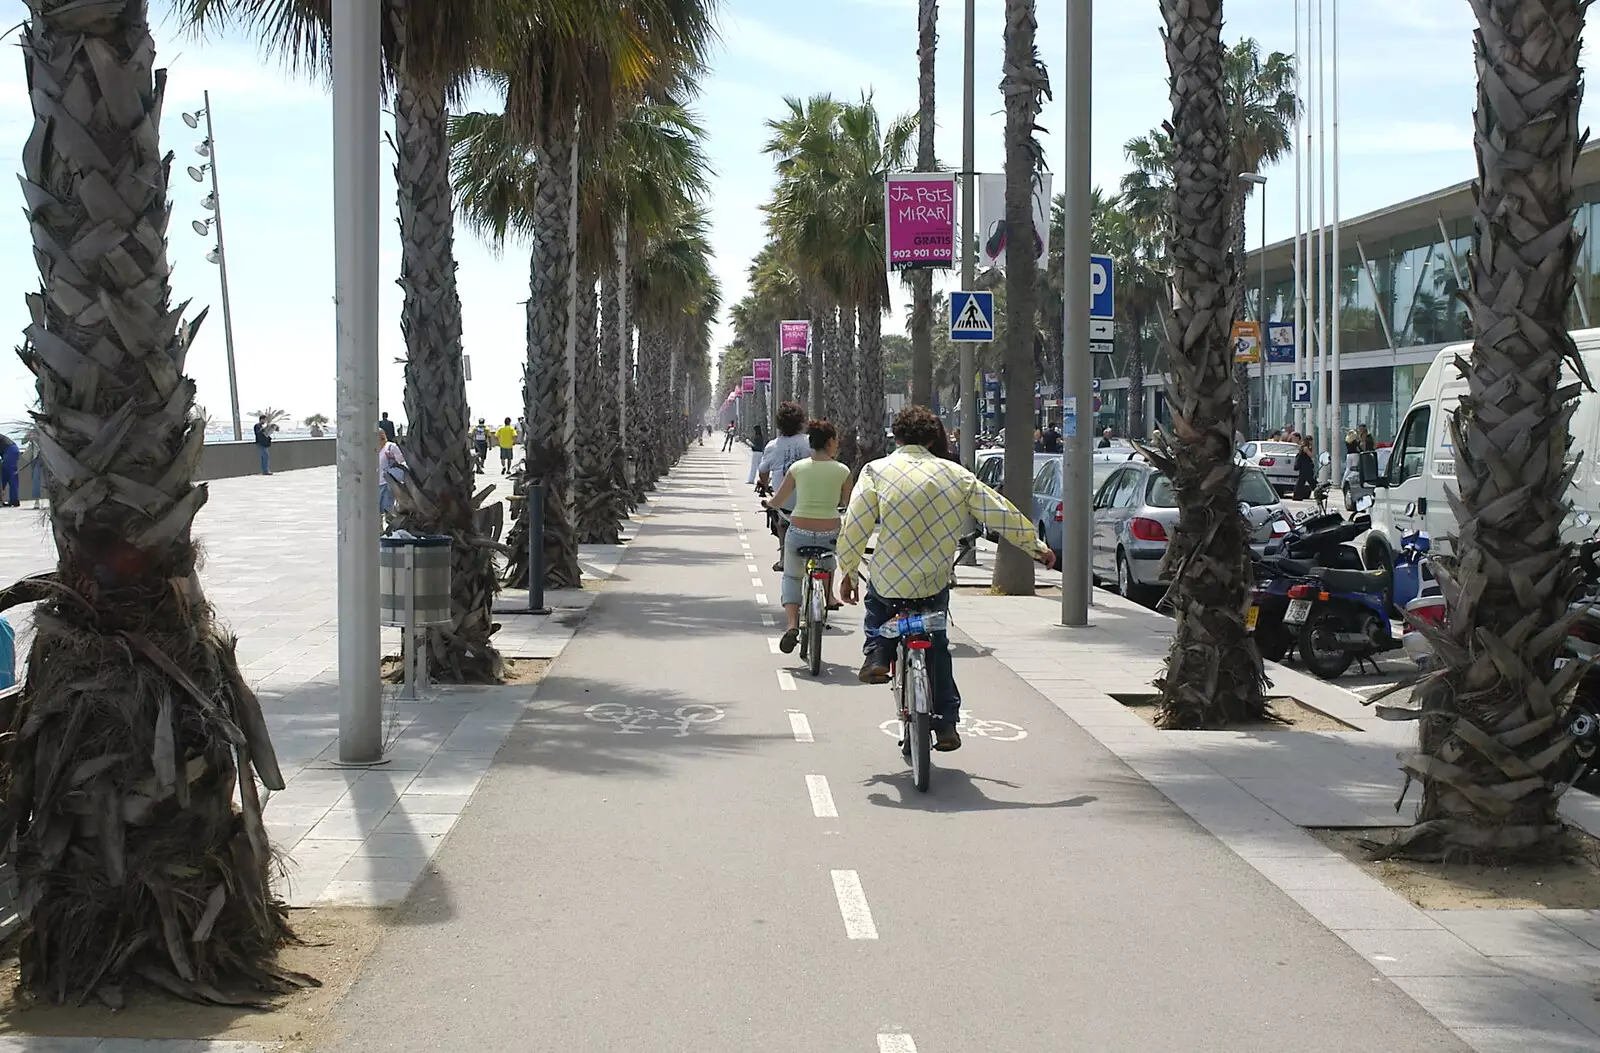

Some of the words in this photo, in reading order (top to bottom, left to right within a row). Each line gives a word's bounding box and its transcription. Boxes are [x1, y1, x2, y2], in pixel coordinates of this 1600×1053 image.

[890, 186, 914, 202] JA
[899, 203, 952, 225] MIRAR!
[914, 236, 951, 245] GRATIS
[893, 249, 911, 258] 902
[913, 248, 930, 257] 901
[933, 248, 951, 256] 039
[1090, 263, 1107, 310] P
[1295, 383, 1308, 401] P
